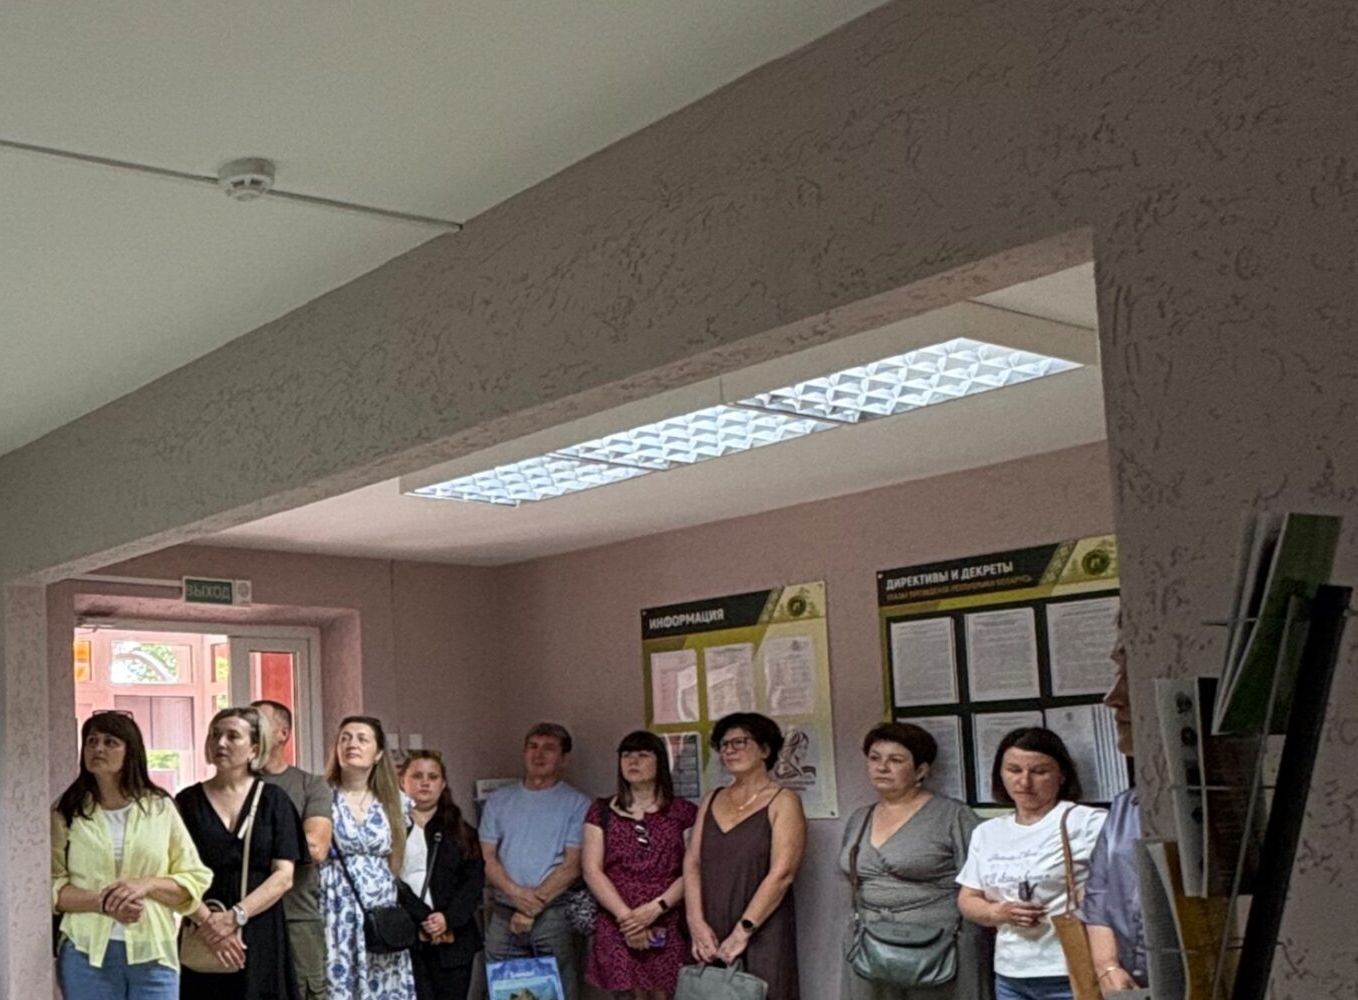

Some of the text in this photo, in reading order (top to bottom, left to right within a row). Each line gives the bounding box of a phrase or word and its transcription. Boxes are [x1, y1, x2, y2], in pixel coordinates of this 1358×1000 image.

[886, 569, 949, 591] ДИРЕКТИВЫ
[950, 568, 959, 581] И
[960, 561, 1013, 580] ДЕКРЕТЫ
[186, 584, 230, 601] ВЫХОД
[648, 607, 724, 630] ИНФОРМАЦИЯ
